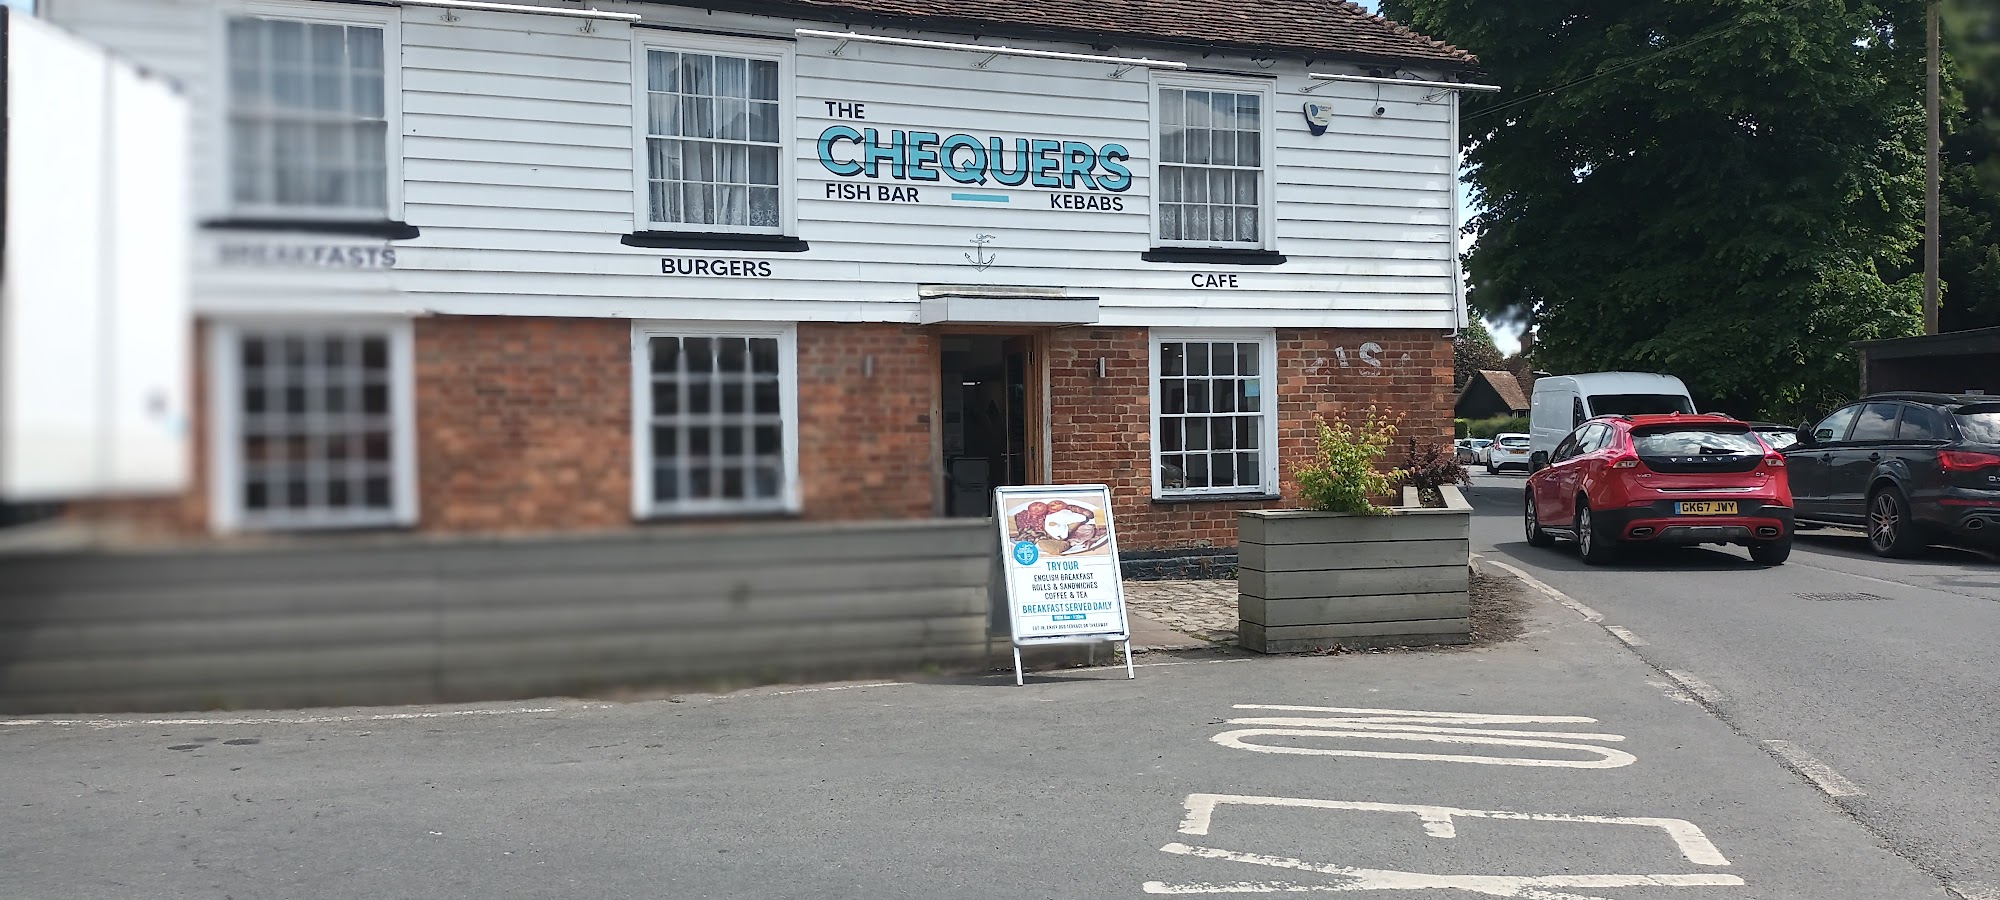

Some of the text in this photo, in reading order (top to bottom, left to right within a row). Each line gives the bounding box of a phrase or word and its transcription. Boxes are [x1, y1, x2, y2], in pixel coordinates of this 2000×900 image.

[825, 101, 865, 119] THE
[817, 125, 1132, 192] CHEQUERS
[826, 183, 920, 203] FISH BAR
[1050, 193, 1124, 211] KEBABS
[661, 258, 772, 277] BURGERS
[1191, 273, 1239, 288] CAFE
[1682, 502, 1735, 512] GK67 JWY
[1046, 560, 1079, 571] TRY OUR
[1033, 572, 1093, 582] ENGLISH BREAKFAST
[1032, 583, 1051, 591] ROLLS
[1059, 581, 1098, 590] SANDWICHES
[1044, 591, 1088, 600] COFFEE & TEA
[1022, 601, 1112, 614] BREAKFAST SERVED DAILY
